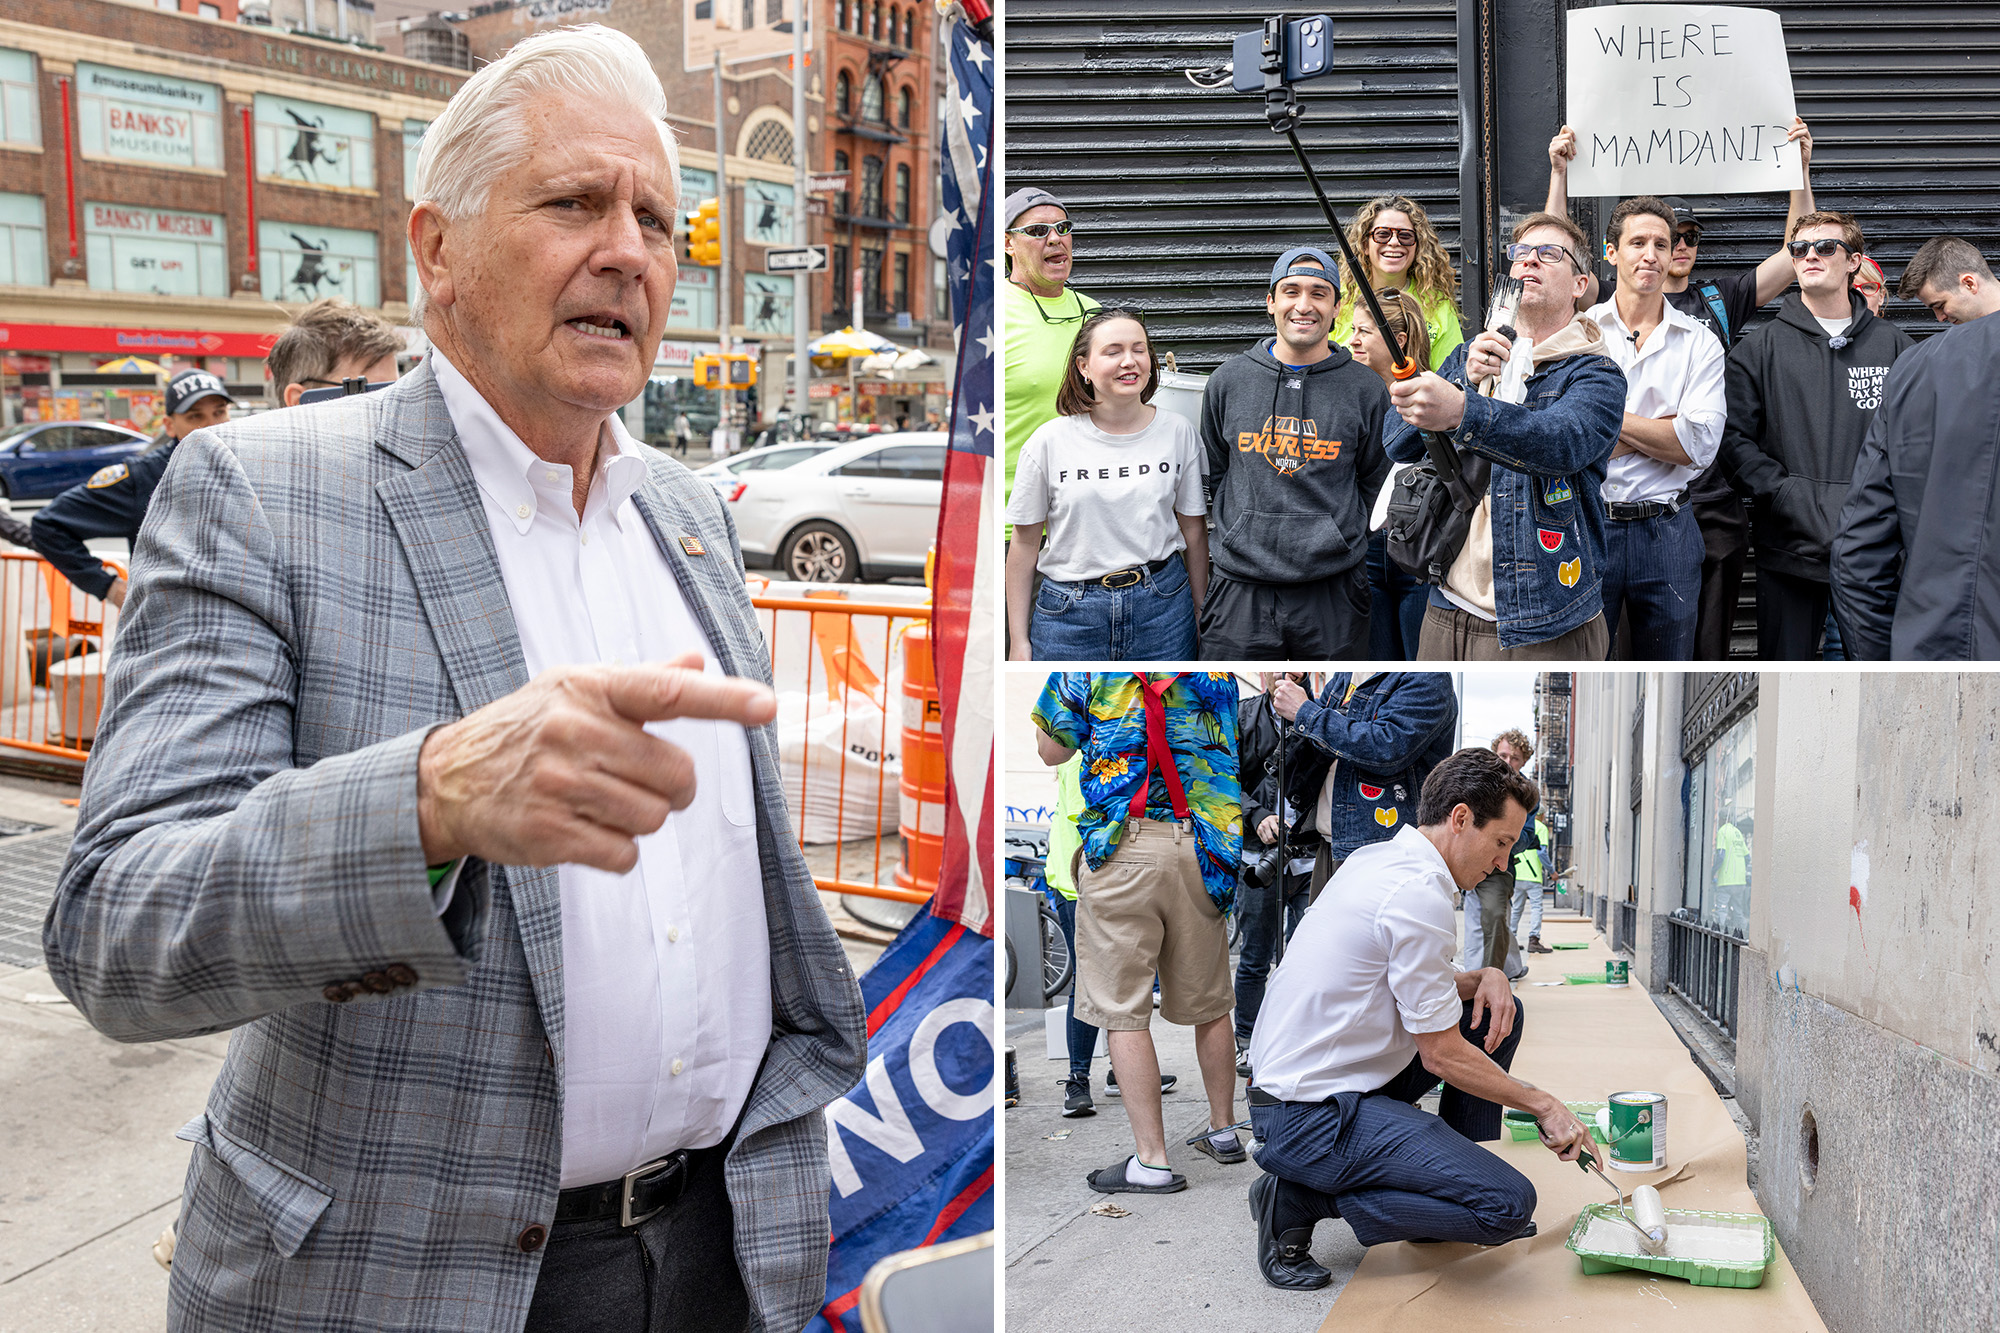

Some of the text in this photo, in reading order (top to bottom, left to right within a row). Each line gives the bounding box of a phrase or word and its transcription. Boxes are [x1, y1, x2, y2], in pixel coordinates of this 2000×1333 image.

[1594, 24, 1733, 63] WHERE
[262, 43, 304, 67] THE
[414, 73, 464, 98] BUIL
[1652, 75, 1692, 108] IS
[110, 108, 187, 139] BANKSY
[110, 134, 191, 157] MUSEUM
[1591, 124, 1793, 169] MAMDANI?
[807, 176, 846, 192] Broadway
[94, 206, 214, 237] BANKSY MUSEUM
[130, 257, 183, 272] GET UP!
[117, 332, 197, 348] Bank of America
[663, 343, 688, 361] Shop
[1847, 366, 1889, 378] WHERE
[172, 373, 221, 399] NYPD
[1848, 375, 1885, 390] DID M
[1848, 388, 1871, 400] TAX
[1856, 396, 1882, 409] GO?
[1238, 432, 1342, 460] EXPRESS
[1275, 456, 1298, 469] NORTH
